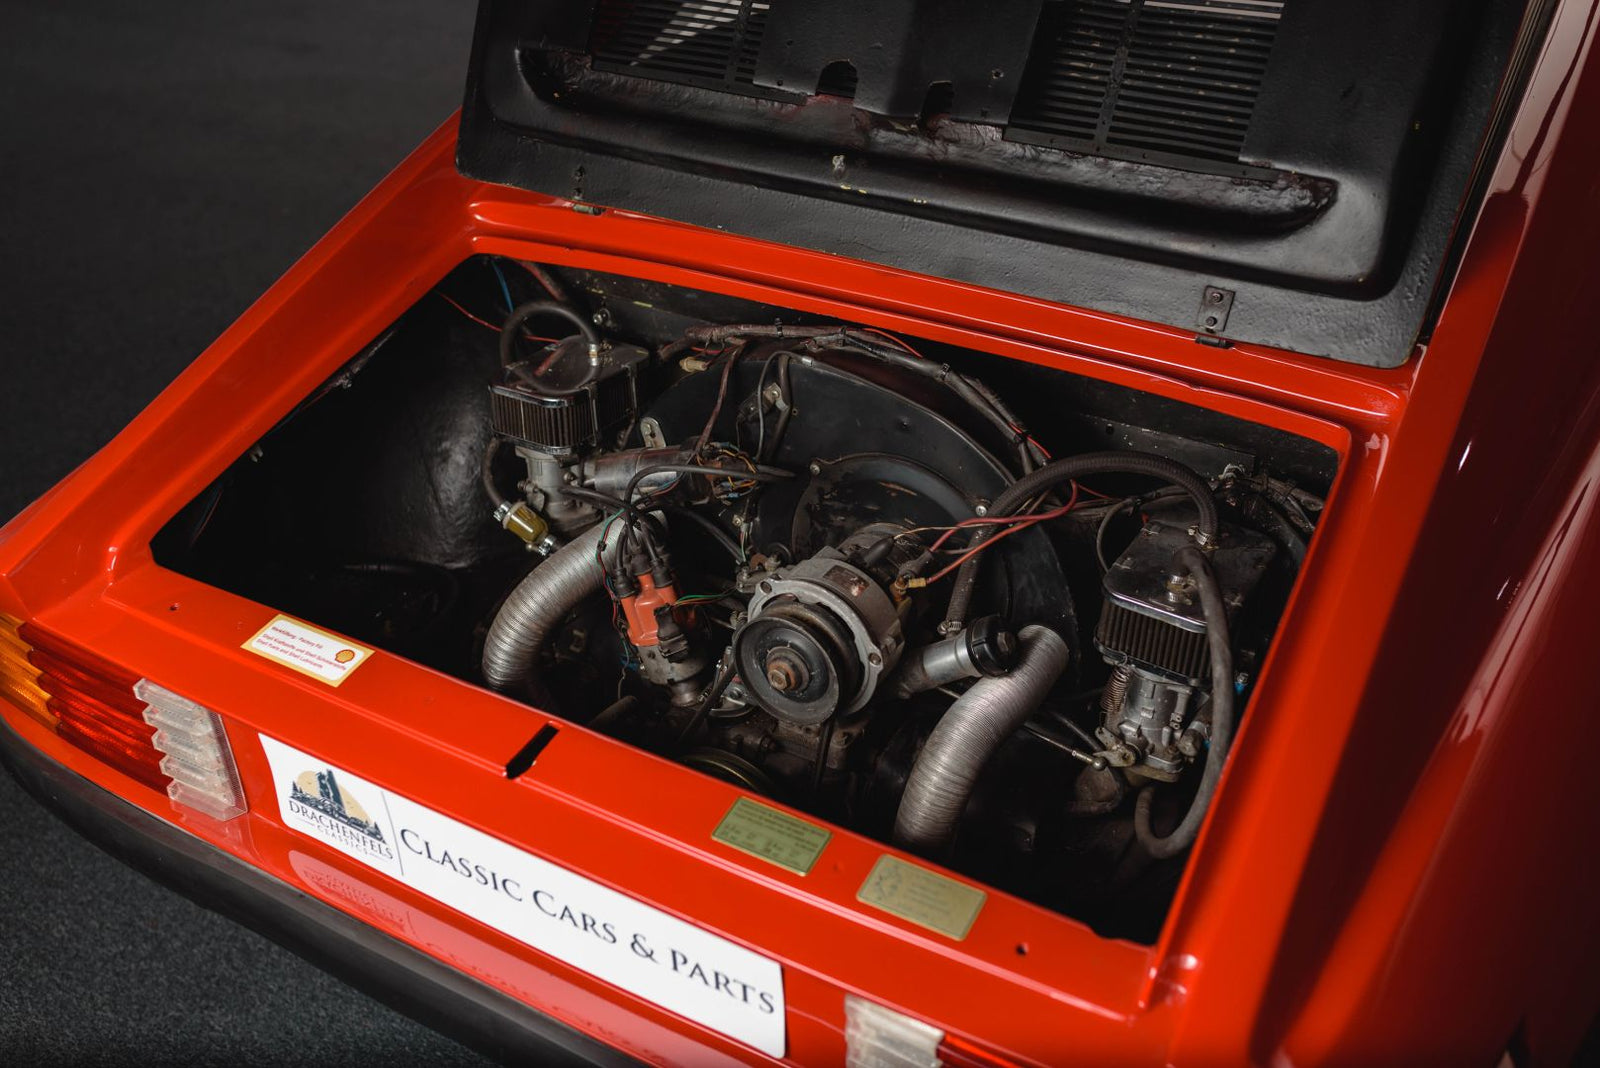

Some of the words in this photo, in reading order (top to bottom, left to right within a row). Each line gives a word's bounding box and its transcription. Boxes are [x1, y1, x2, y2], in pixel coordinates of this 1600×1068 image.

[289, 800, 393, 860] DRACHENFELS
[317, 824, 368, 855] CLASSICS
[400, 828, 523, 902] CLASSIC
[532, 890, 617, 944] CARS
[630, 933, 661, 965] &
[669, 948, 775, 1014] PARTS
